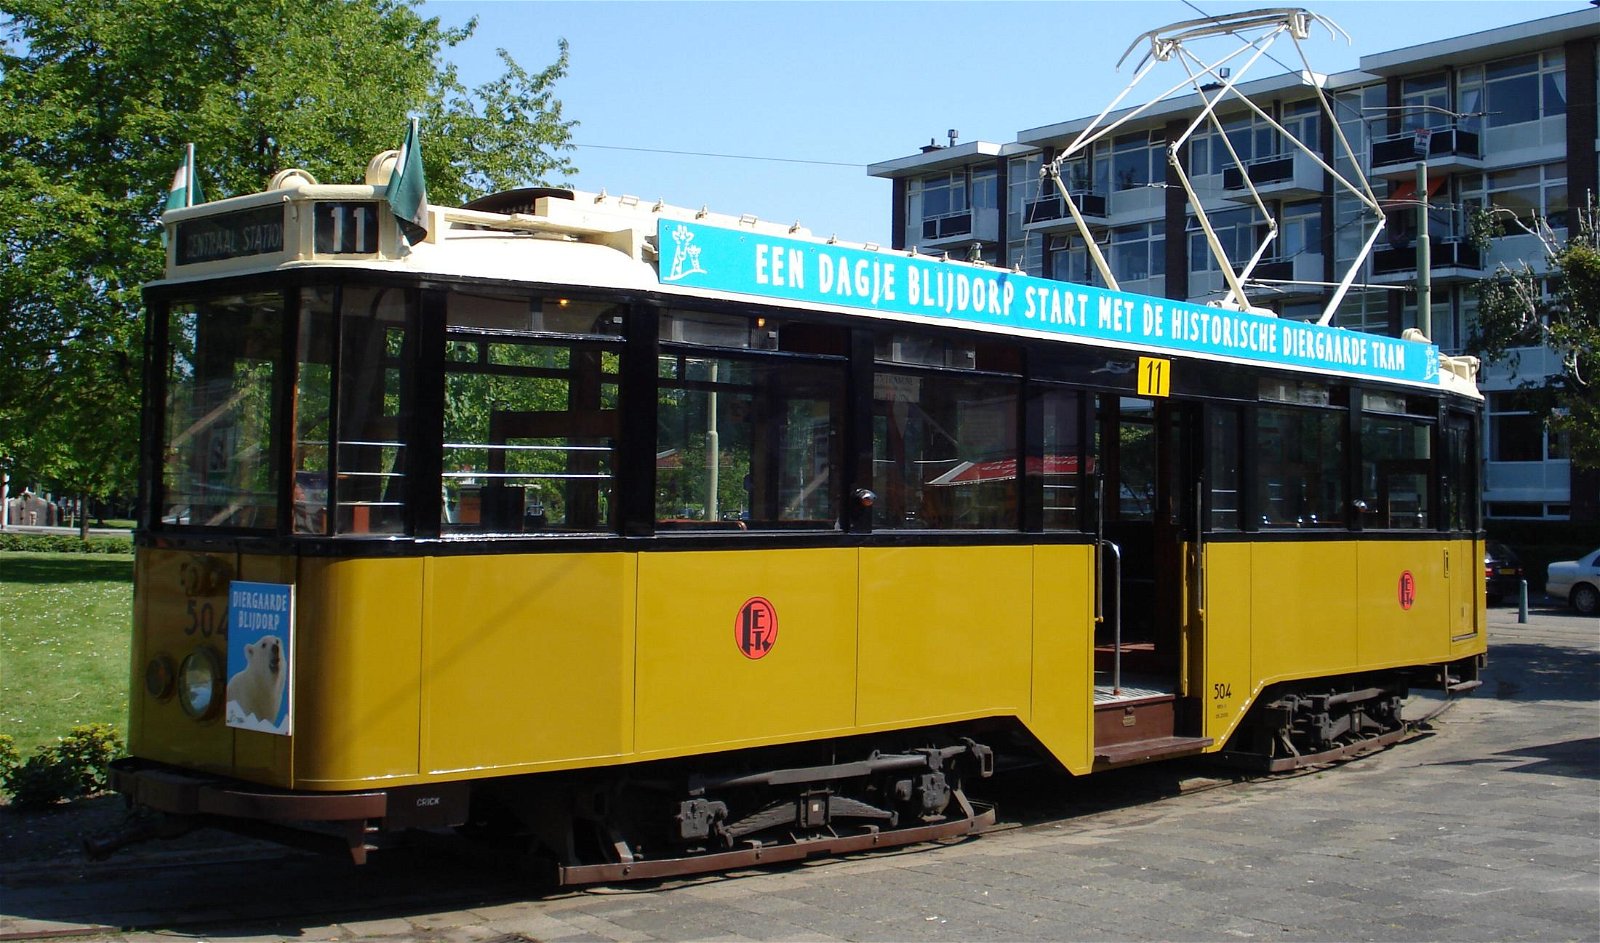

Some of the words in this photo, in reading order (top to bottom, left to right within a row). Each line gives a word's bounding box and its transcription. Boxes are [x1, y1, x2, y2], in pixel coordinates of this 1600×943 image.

[331, 206, 365, 252] 11
[755, 243, 805, 289] EEN
[818, 253, 896, 305] DAGJE
[907, 265, 1015, 317] BLIJDORP
[1024, 287, 1087, 327] START
[1098, 297, 1134, 333] MET
[1143, 302, 1164, 337] DE
[1171, 307, 1277, 353] HISTORISCHE
[1282, 327, 1367, 367] DIERGAARDE
[1371, 341, 1406, 371] TRAM
[1146, 360, 1162, 395] 11
[232, 590, 287, 612] DIERGAARDE
[238, 610, 280, 631] BLIJDORP
[1214, 683, 1232, 700] 504
